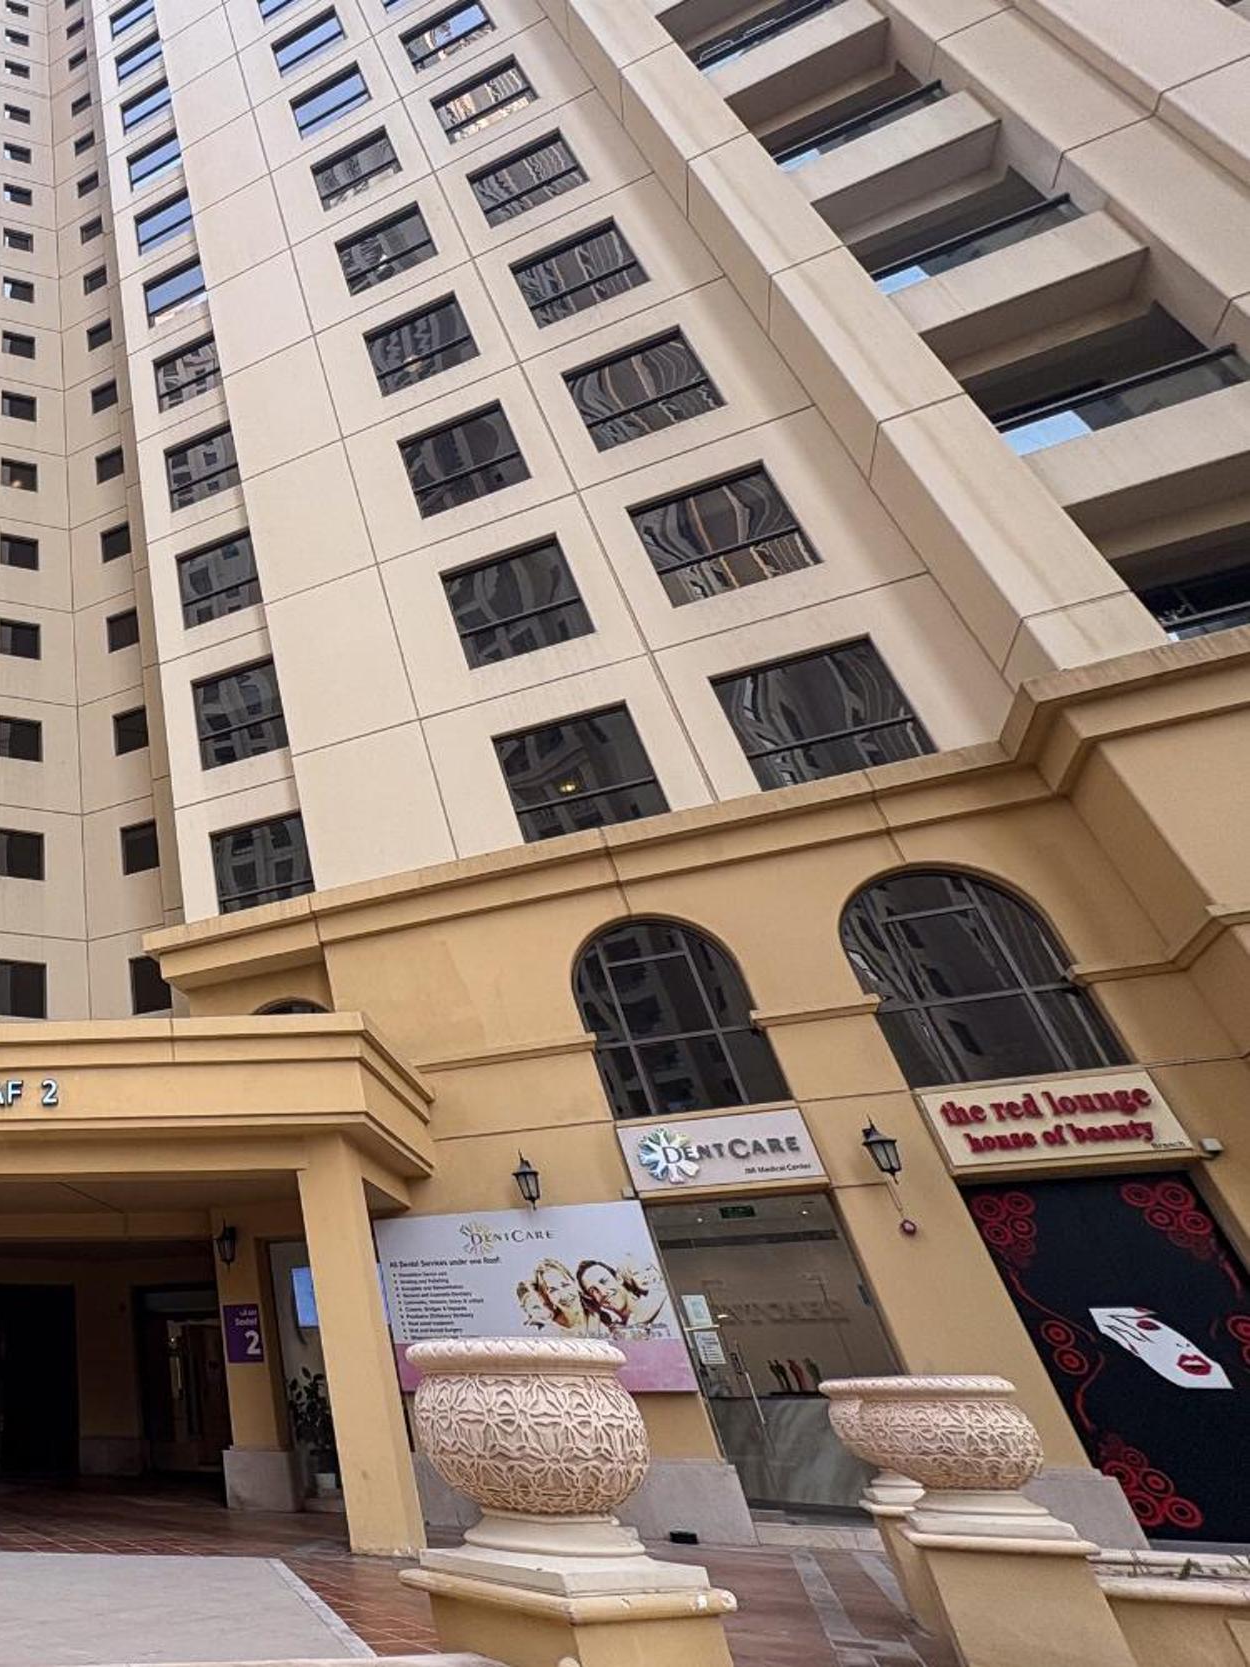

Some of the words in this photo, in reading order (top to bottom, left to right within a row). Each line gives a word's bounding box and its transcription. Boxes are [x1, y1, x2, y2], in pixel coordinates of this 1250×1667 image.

[41, 1079, 59, 1106] 2
[940, 1101, 987, 1125] the
[990, 1093, 1043, 1120] red
[1041, 1088, 1152, 1116] lounge
[964, 1132, 1037, 1153] house
[1041, 1124, 1068, 1147] of
[1067, 1120, 1155, 1143] beauty
[758, 1165, 785, 1173] Medical
[244, 1330, 261, 1354] 2
